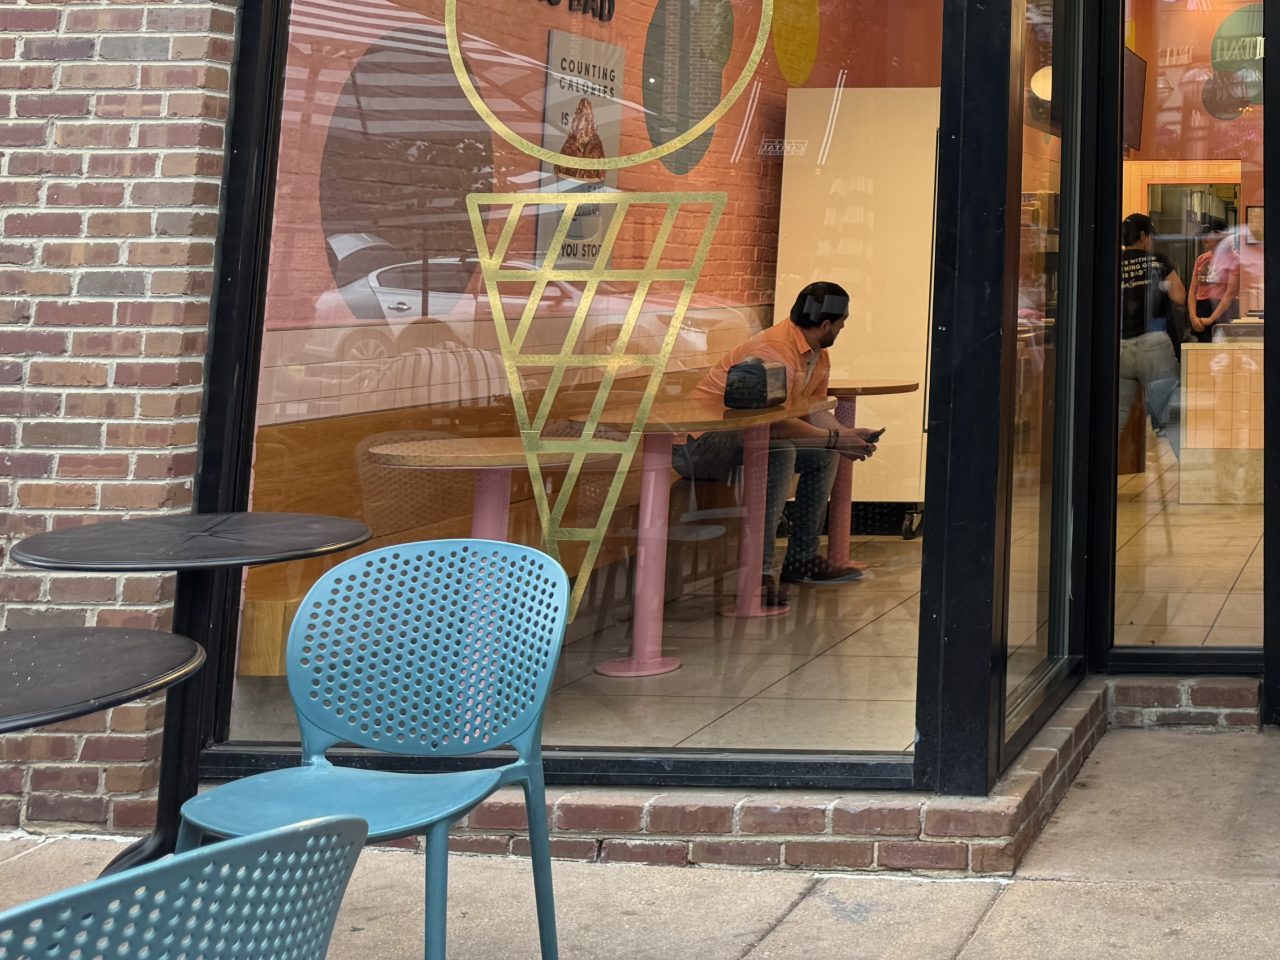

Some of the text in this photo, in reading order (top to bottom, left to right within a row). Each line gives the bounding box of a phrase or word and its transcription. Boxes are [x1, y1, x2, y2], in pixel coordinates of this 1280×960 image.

[561, 57, 616, 82] COUNTING
[559, 76, 615, 98] CALORIES
[561, 112, 569, 126] IS
[561, 243, 578, 257] YOU
